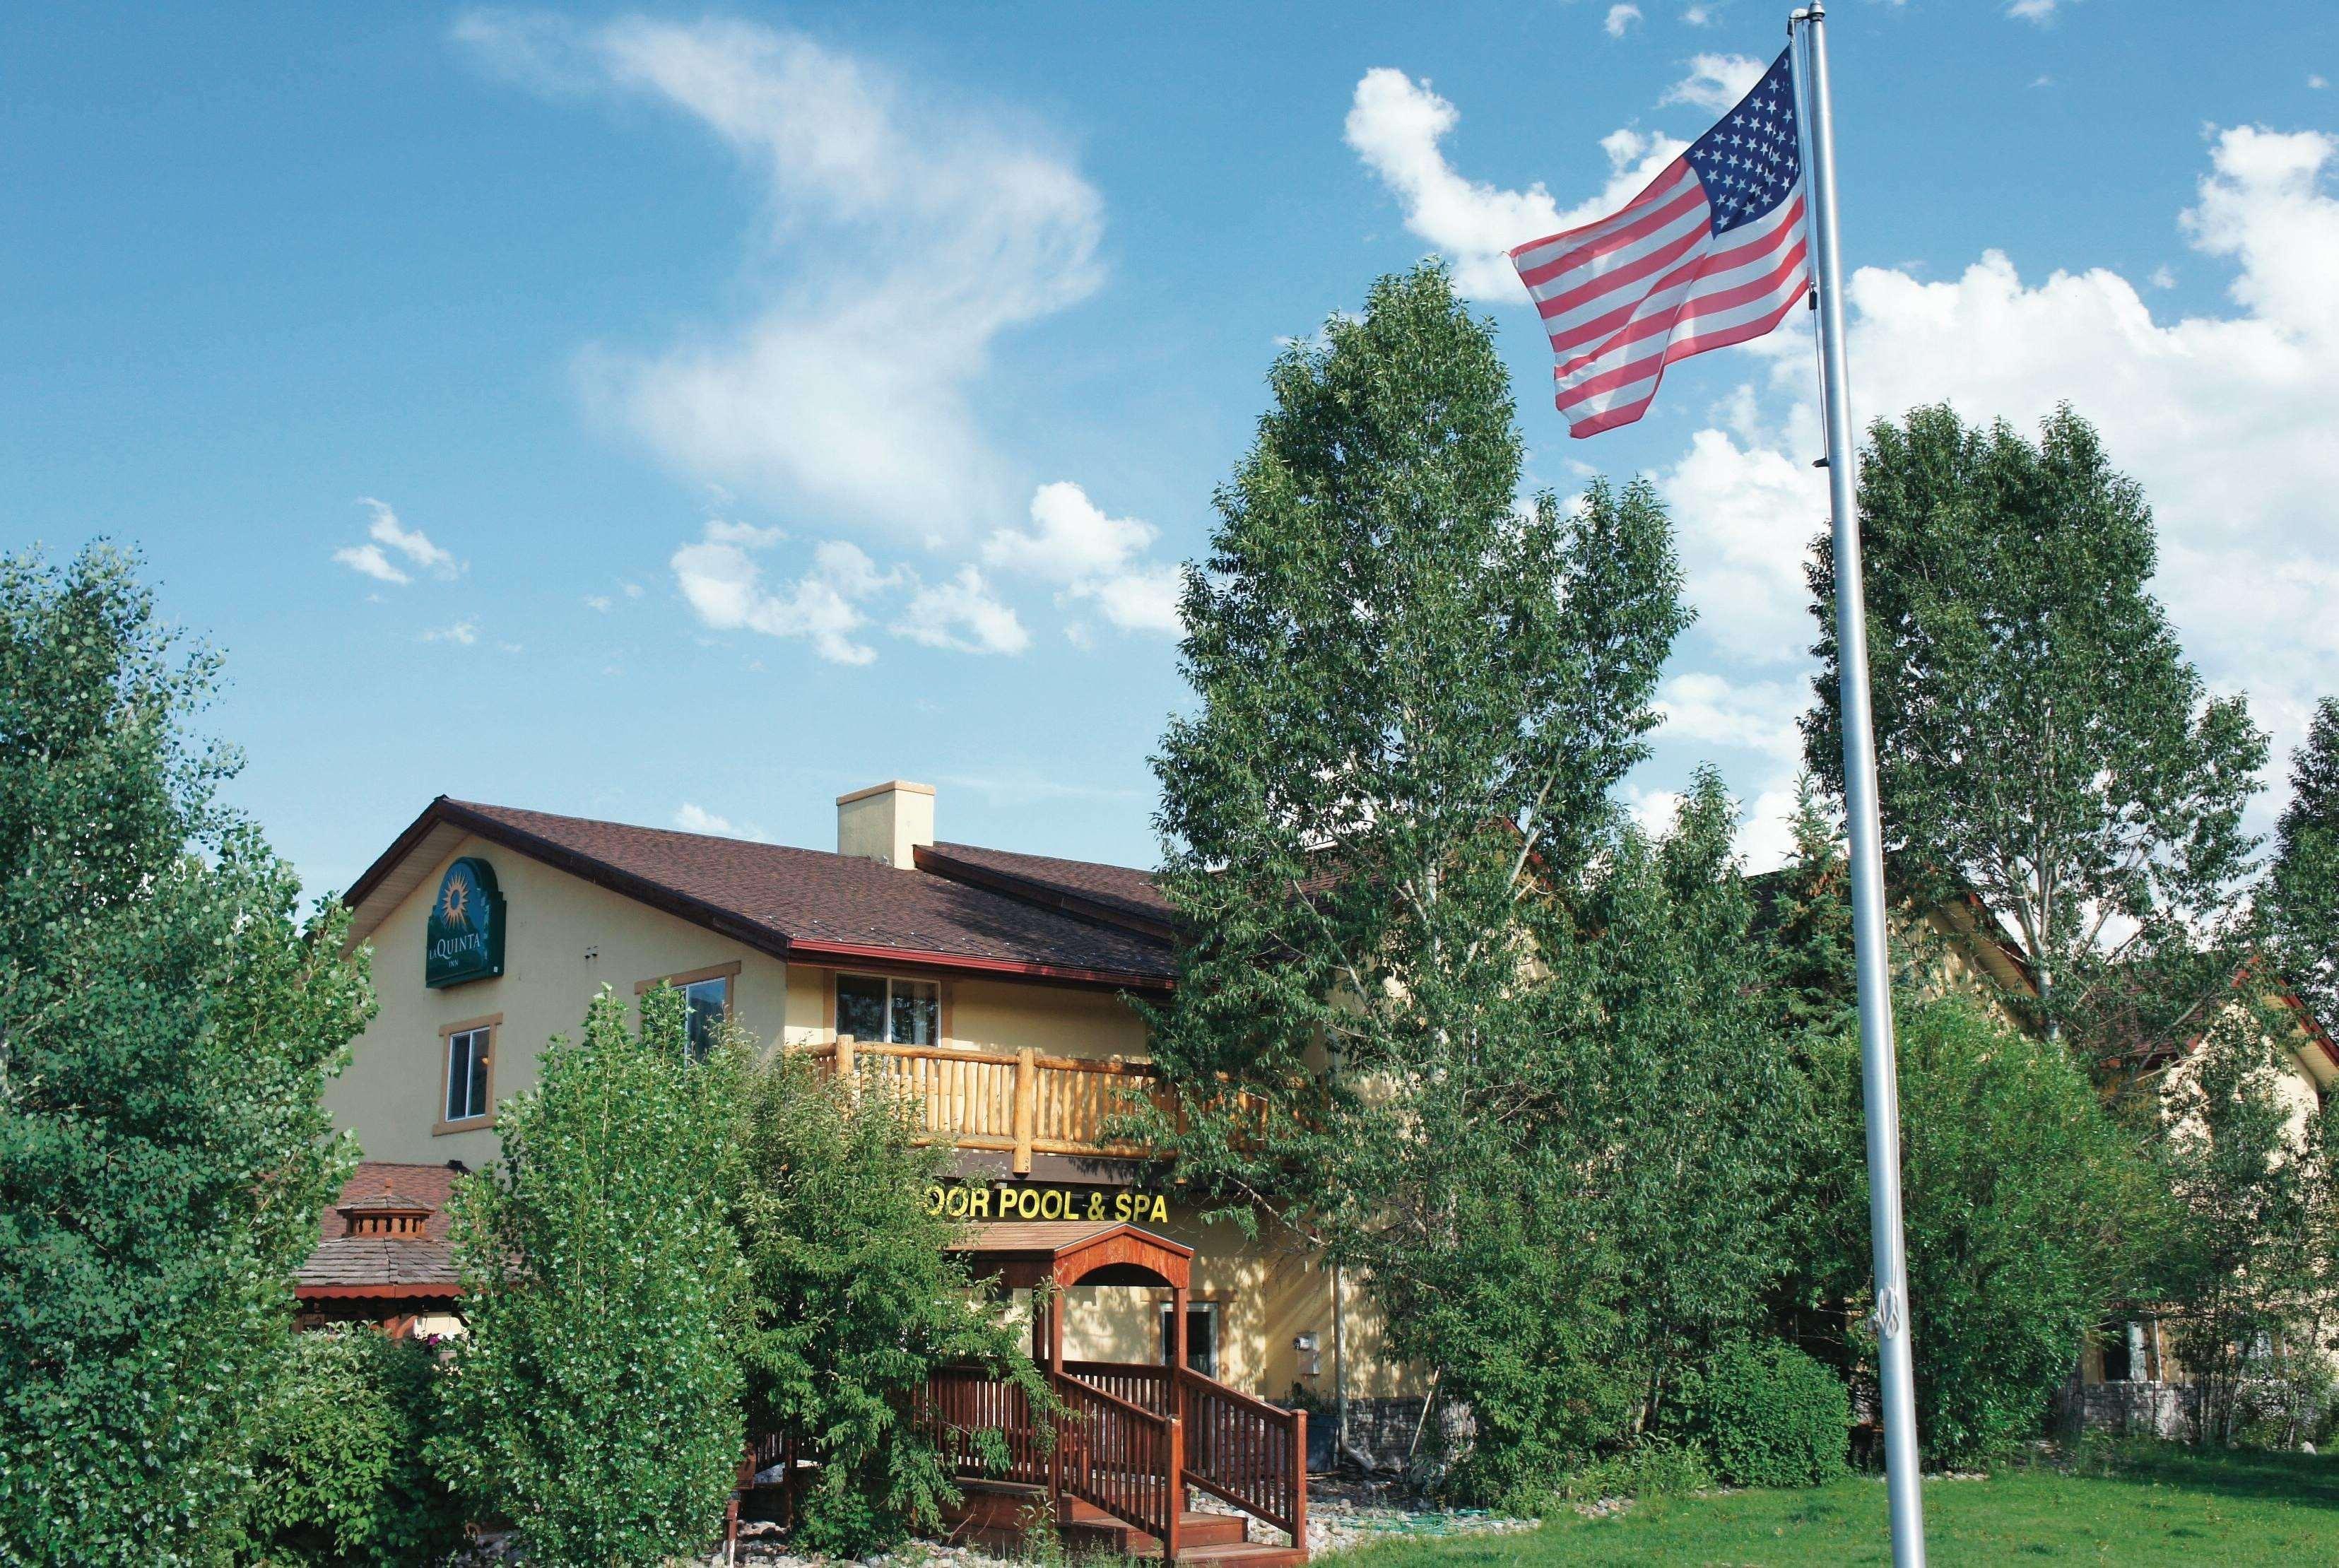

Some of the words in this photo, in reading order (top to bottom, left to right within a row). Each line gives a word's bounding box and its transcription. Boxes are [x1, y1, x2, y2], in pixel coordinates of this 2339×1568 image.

[430, 948, 437, 960] LA
[437, 933, 480, 960] QUINTA
[448, 959, 459, 968] INN
[998, 1189, 1079, 1220] POOL
[1087, 1192, 1104, 1221] &
[1114, 1193, 1168, 1223] SPA
